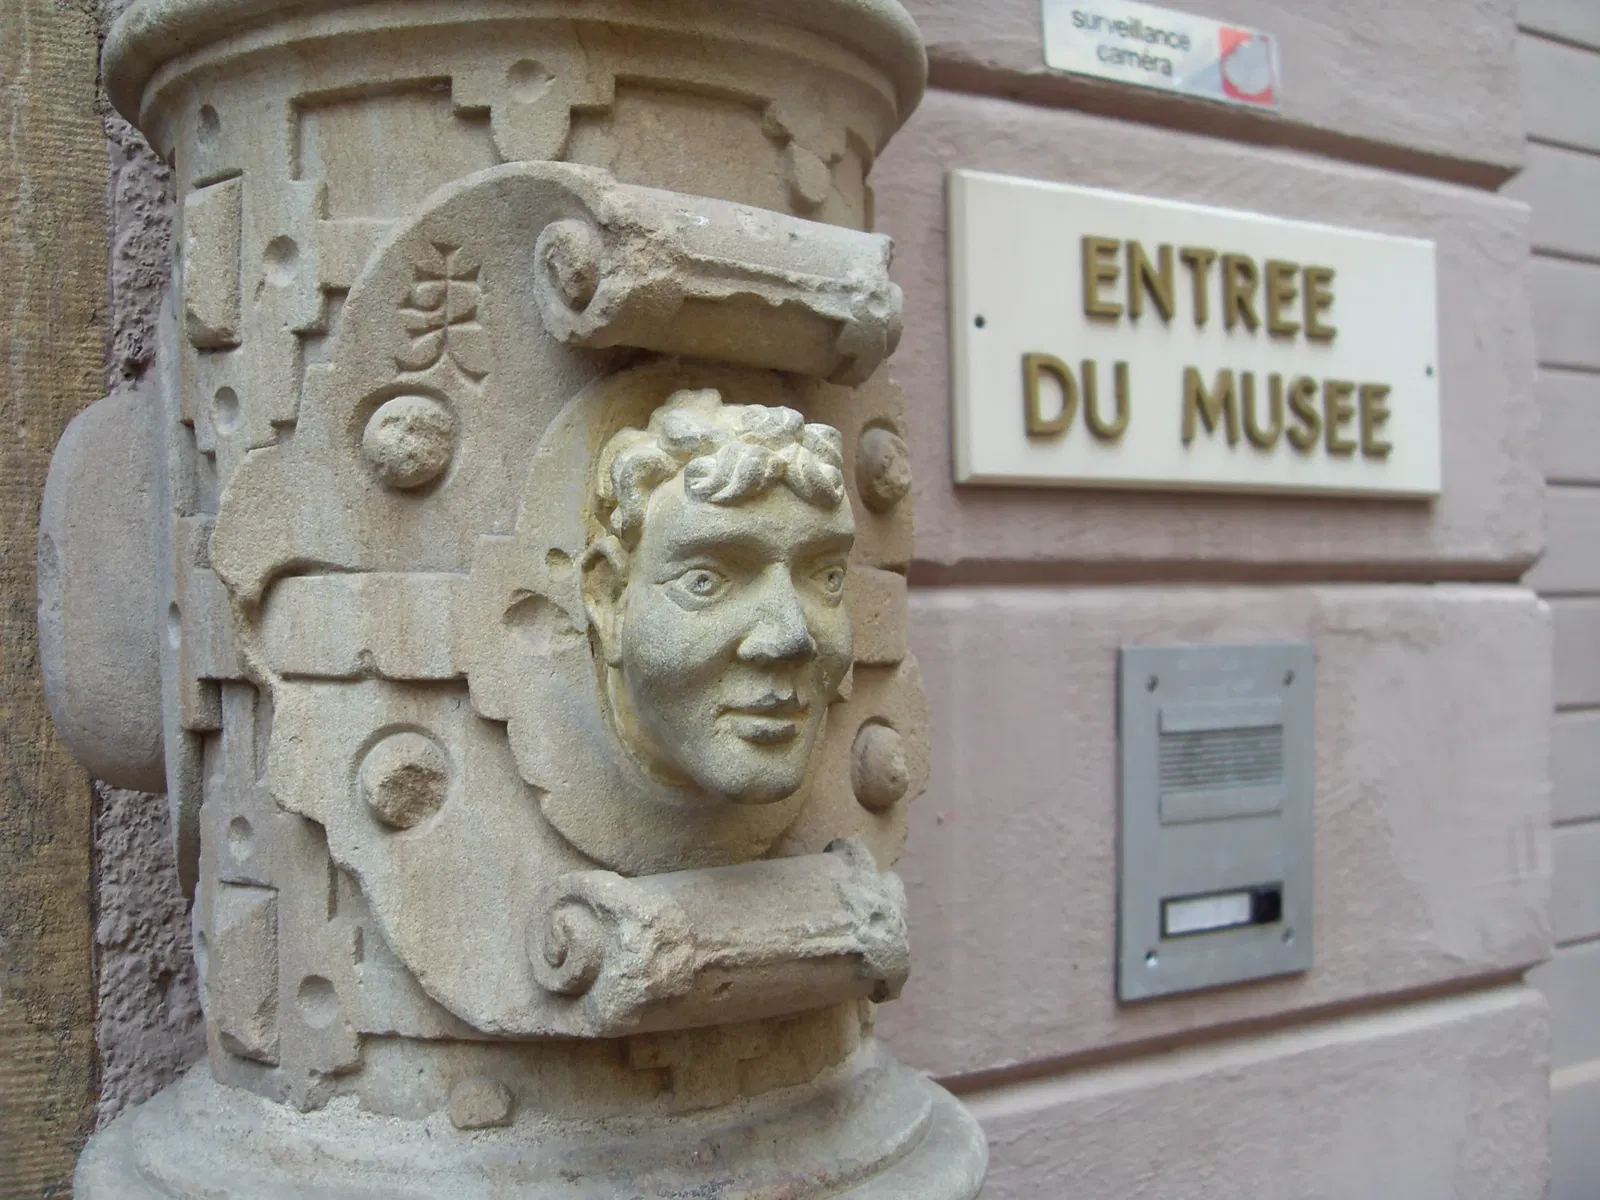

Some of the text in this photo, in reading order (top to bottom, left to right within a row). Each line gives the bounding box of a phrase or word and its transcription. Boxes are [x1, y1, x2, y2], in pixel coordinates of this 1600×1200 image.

[1071, 10, 1191, 51] surveillance
[1081, 235, 1337, 341] ENTREE
[1022, 353, 1392, 460] DU MUSEE
